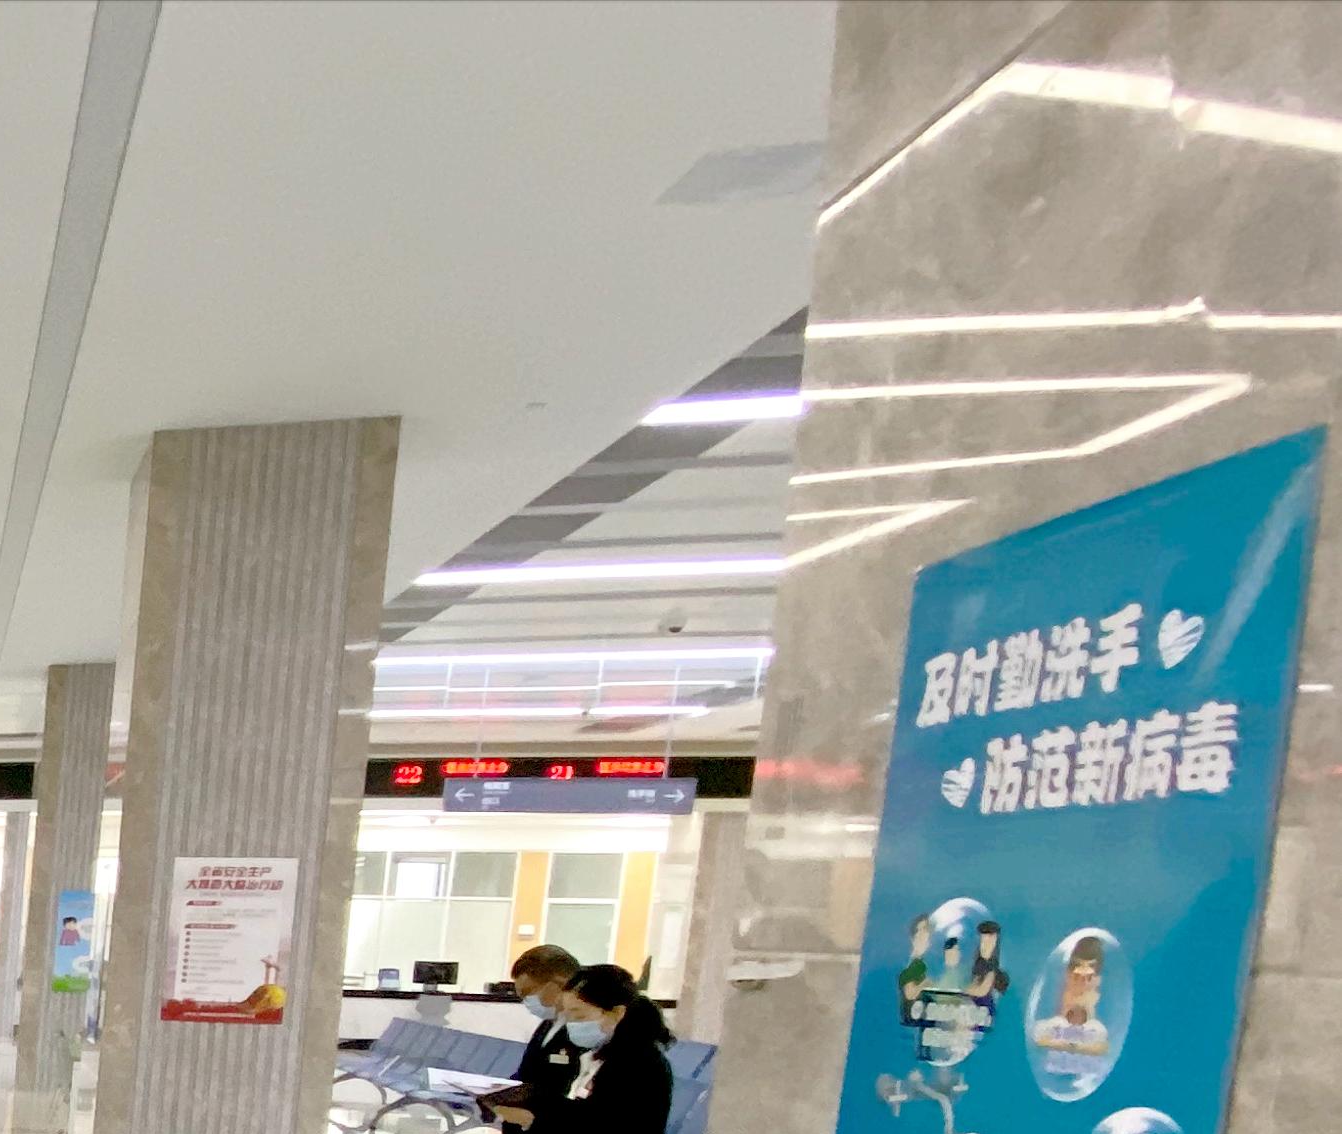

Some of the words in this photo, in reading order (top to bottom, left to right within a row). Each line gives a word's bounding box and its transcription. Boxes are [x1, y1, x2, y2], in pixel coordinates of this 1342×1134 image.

[916, 603, 1143, 727] 及时勤洗手
[394, 765, 423, 784] 22
[981, 702, 1239, 813] 防范新病毒
